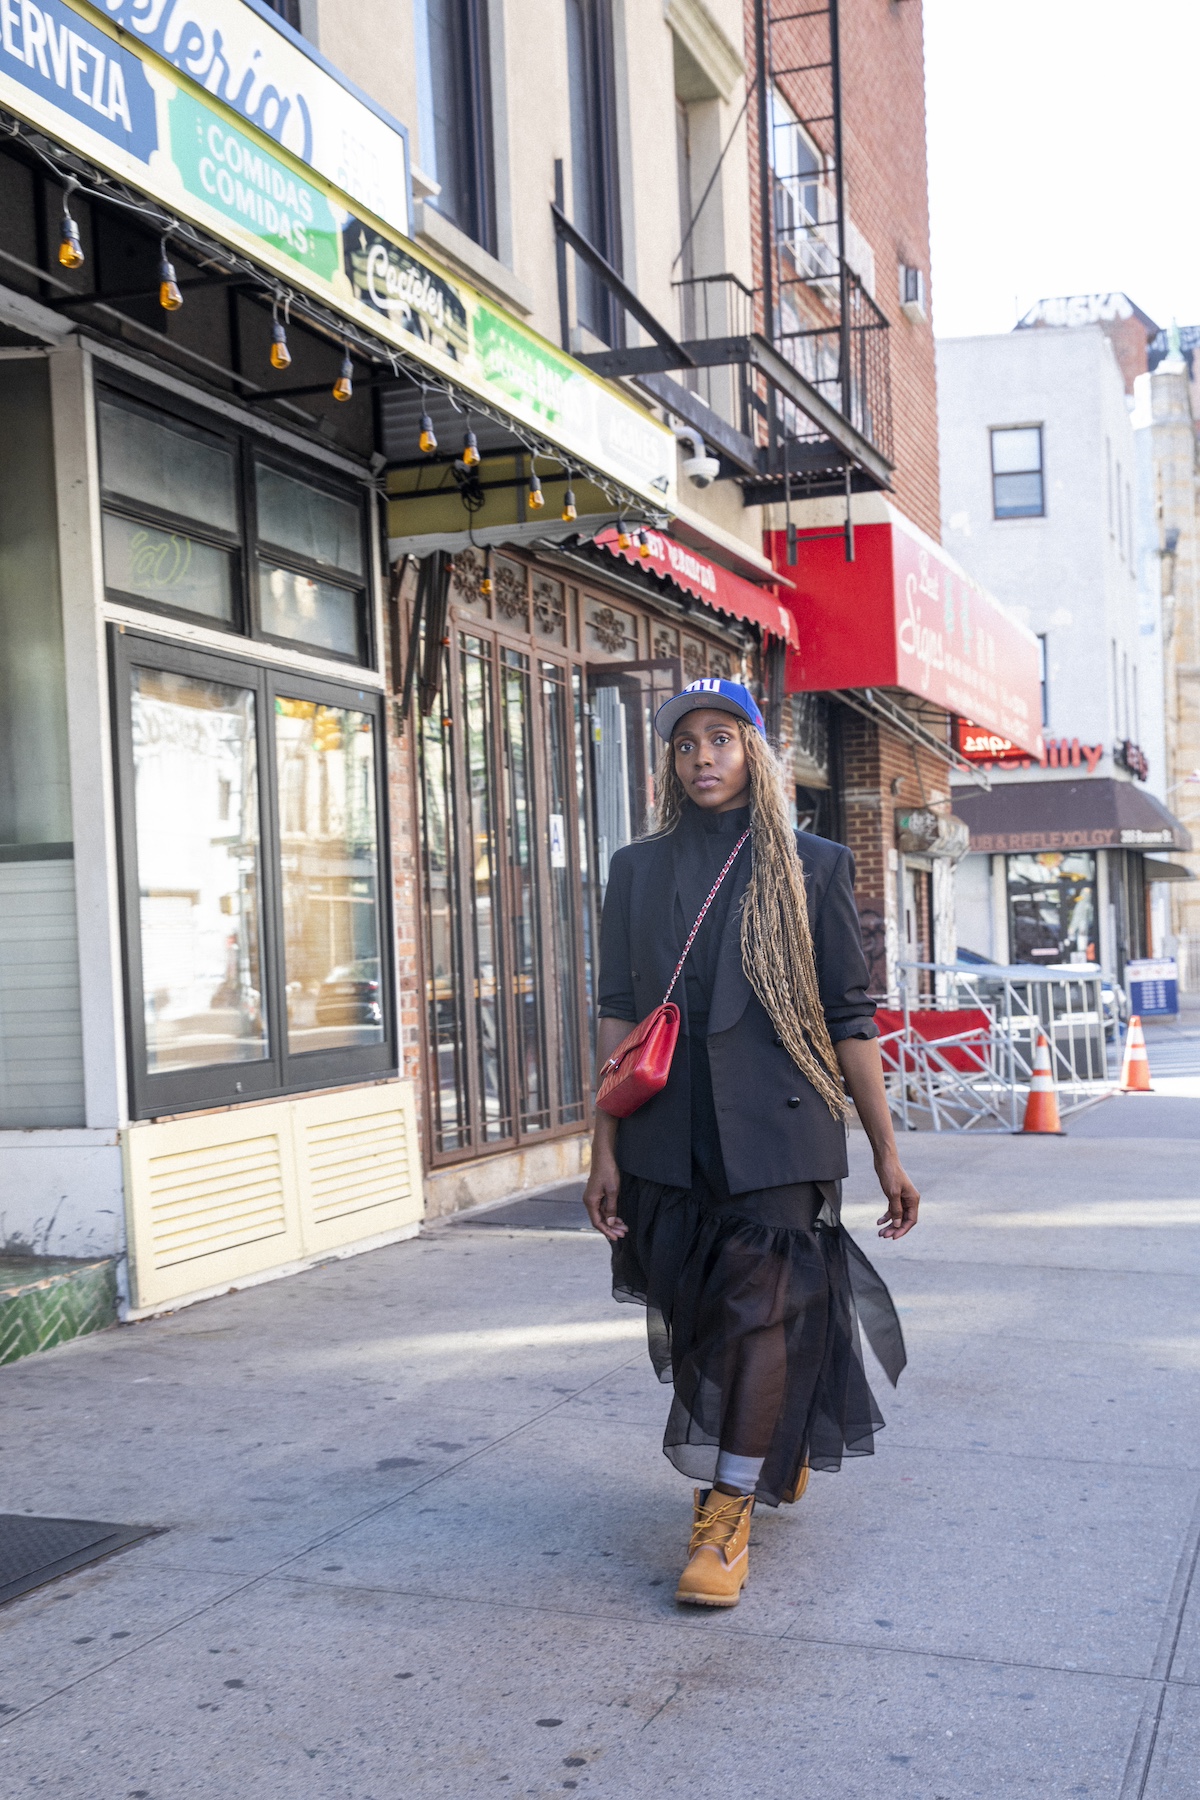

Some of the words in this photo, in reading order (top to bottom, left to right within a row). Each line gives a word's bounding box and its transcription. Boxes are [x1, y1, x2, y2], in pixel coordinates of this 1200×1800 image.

[0, 0, 134, 134] ERVEZA
[198, 157, 308, 254] COMIDAS
[207, 124, 314, 223] COMIDAS
[367, 244, 444, 329] Cocteles
